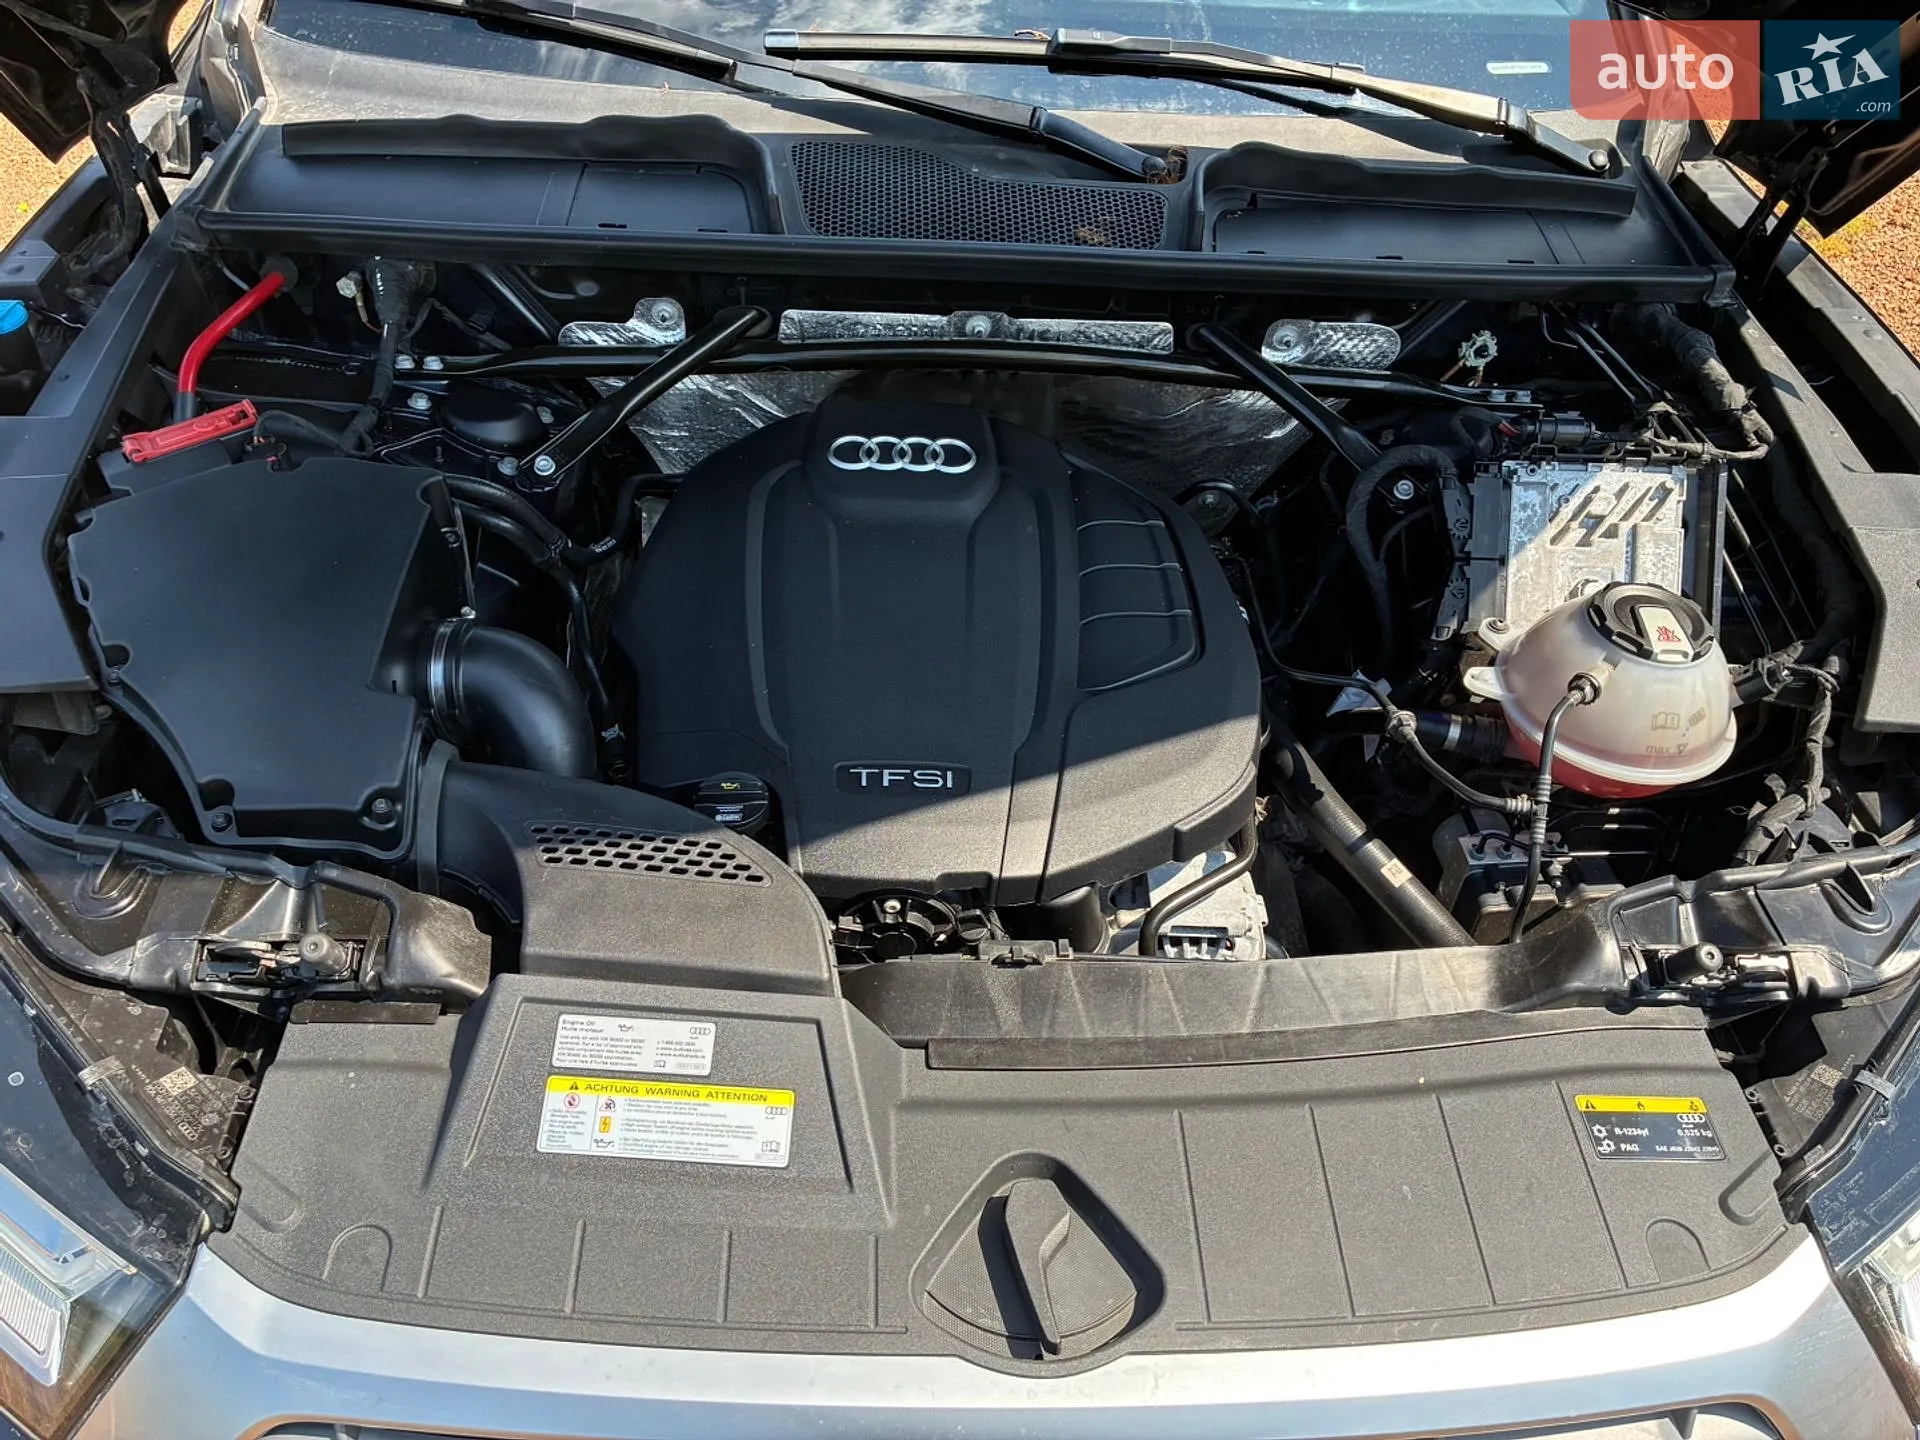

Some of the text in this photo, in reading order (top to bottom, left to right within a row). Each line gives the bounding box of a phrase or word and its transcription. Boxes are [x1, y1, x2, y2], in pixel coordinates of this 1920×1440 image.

[1646, 744, 1672, 754] max
[849, 768, 953, 788] TFSI
[584, 1083, 768, 1102] ACHTUNG WARNING ATTENTION
[1701, 1129, 1713, 1138] kg
[1619, 1143, 1640, 1152] PAG
